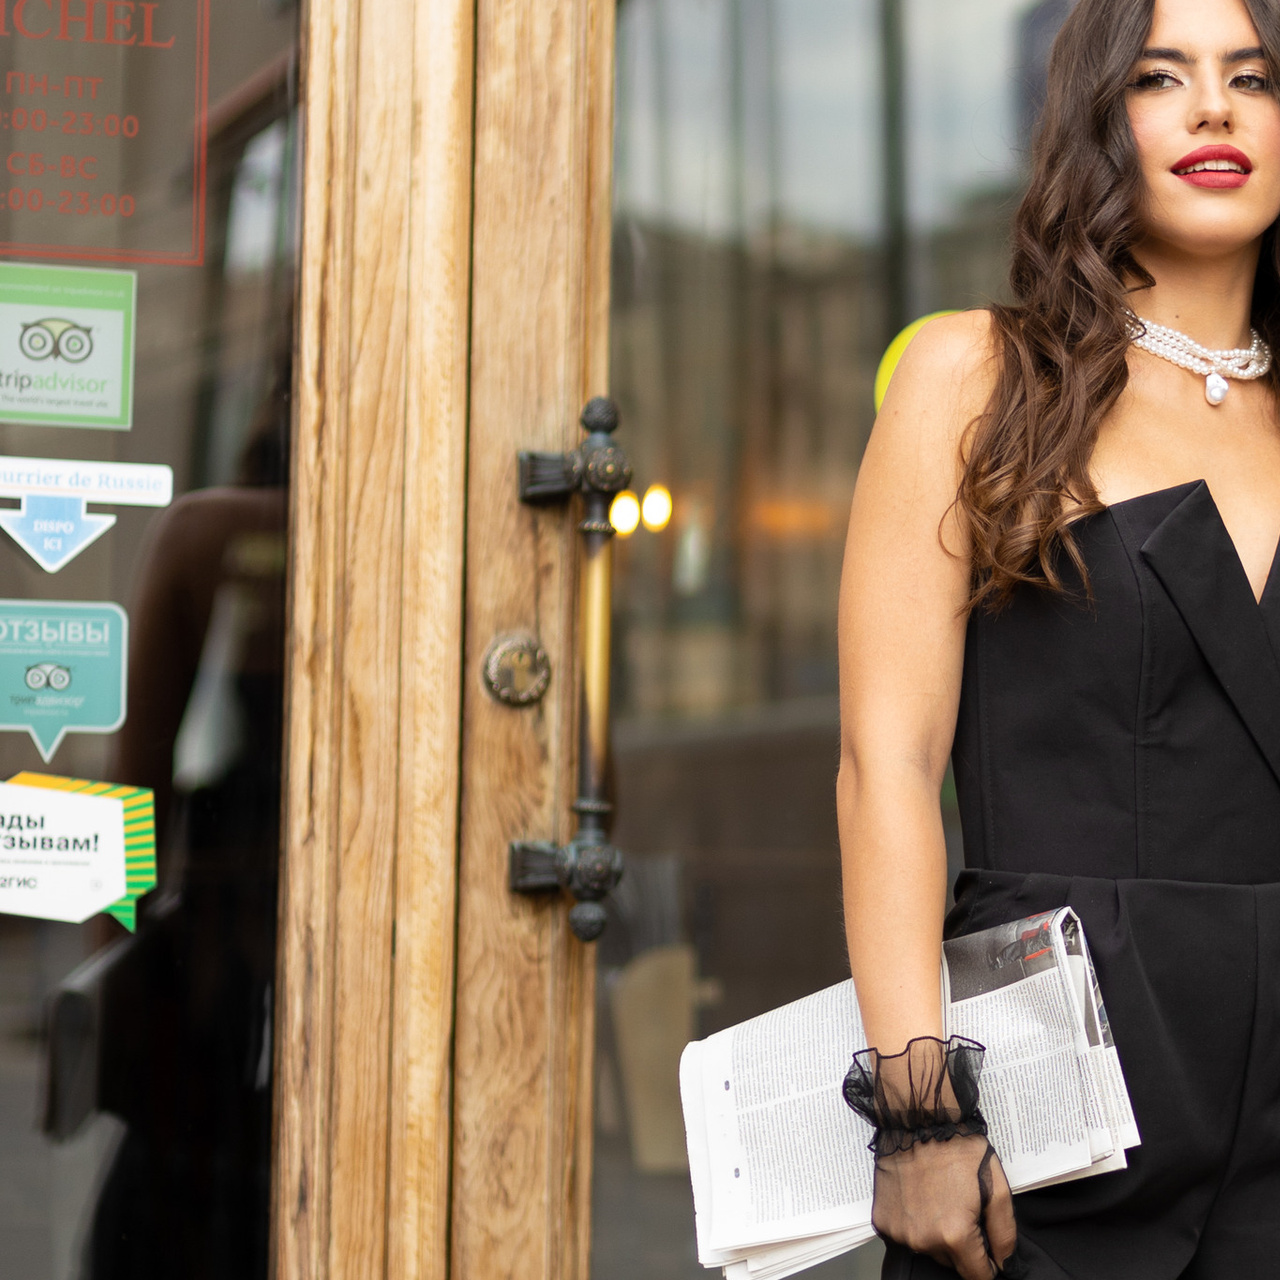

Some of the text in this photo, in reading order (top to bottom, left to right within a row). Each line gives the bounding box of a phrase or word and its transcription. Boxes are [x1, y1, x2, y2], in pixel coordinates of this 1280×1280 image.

[6, 71, 103, 99] ПН-ПТ
[6, 152, 98, 180] СБ-ВС
[68, 471, 91, 487] de
[98, 473, 163, 491] Russie
[33, 520, 74, 534] DISPO
[43, 537, 62, 551] ICI
